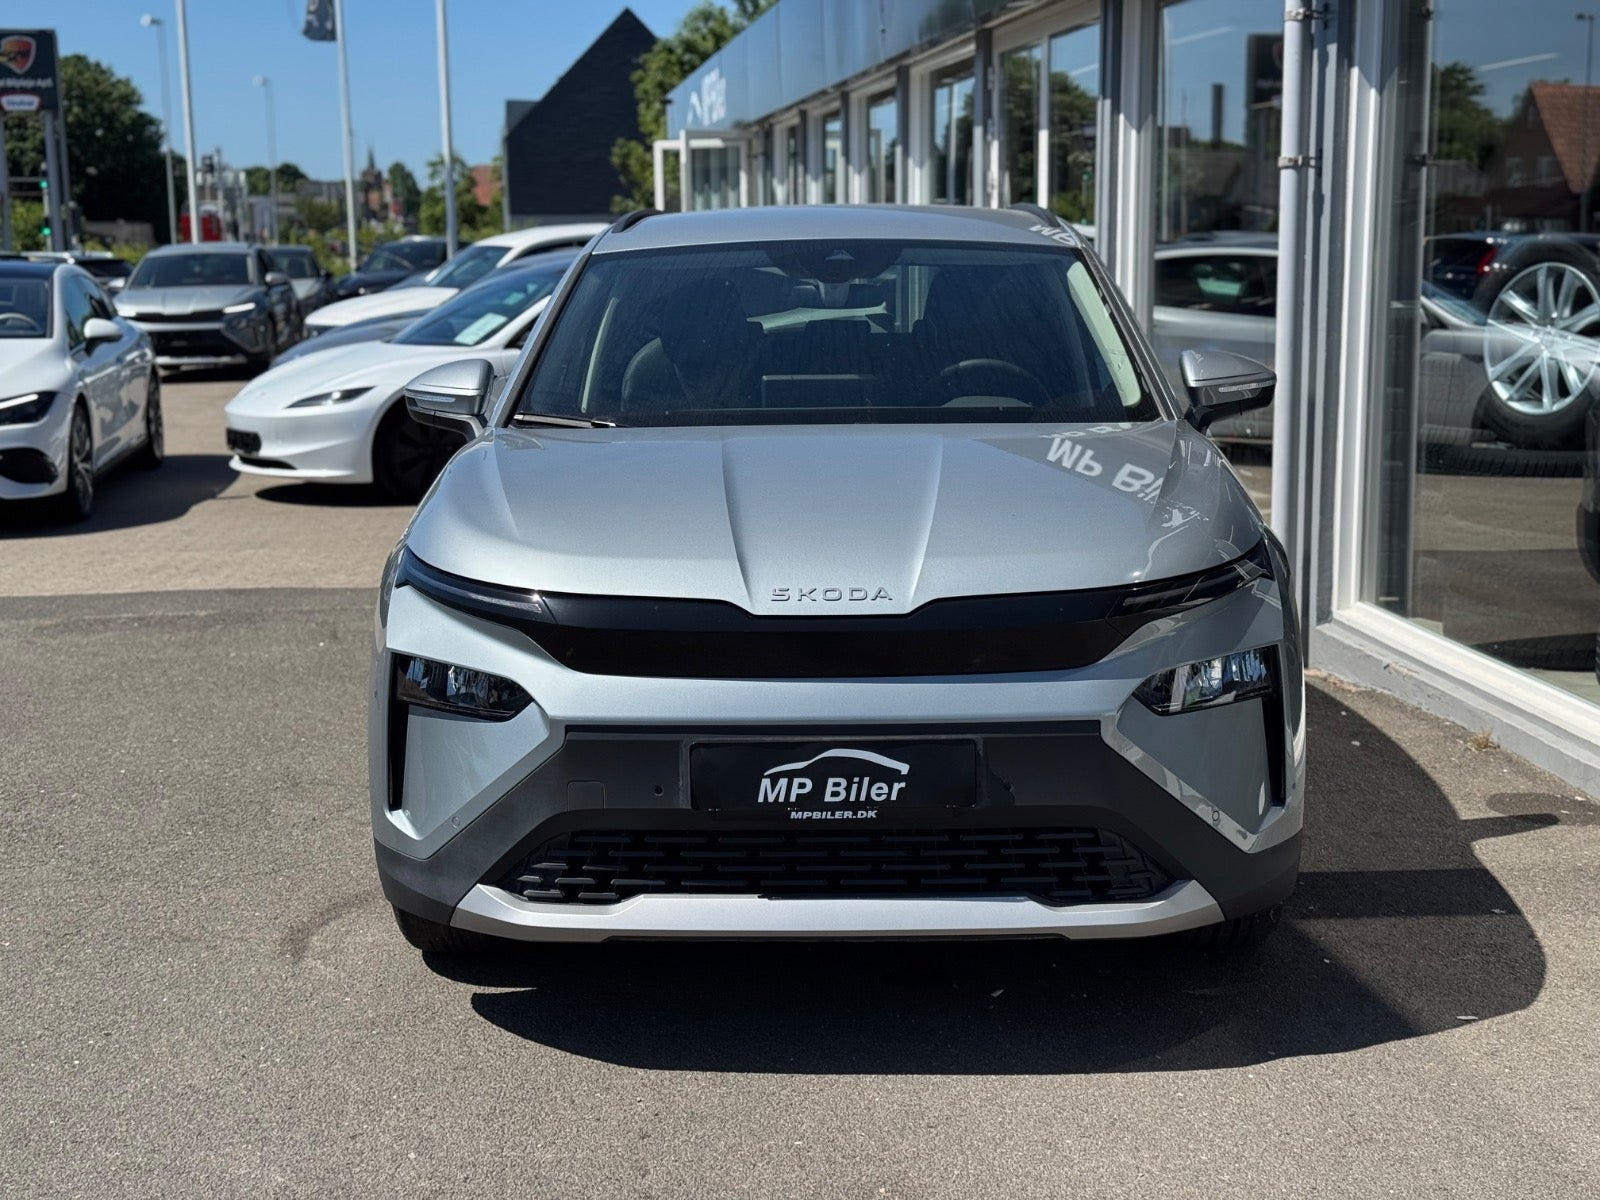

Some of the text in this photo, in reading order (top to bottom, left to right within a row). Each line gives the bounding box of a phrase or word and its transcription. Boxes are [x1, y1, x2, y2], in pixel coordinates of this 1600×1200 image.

[757, 777, 905, 803] MP Biler
[790, 810, 877, 819] MPBILER.DK
